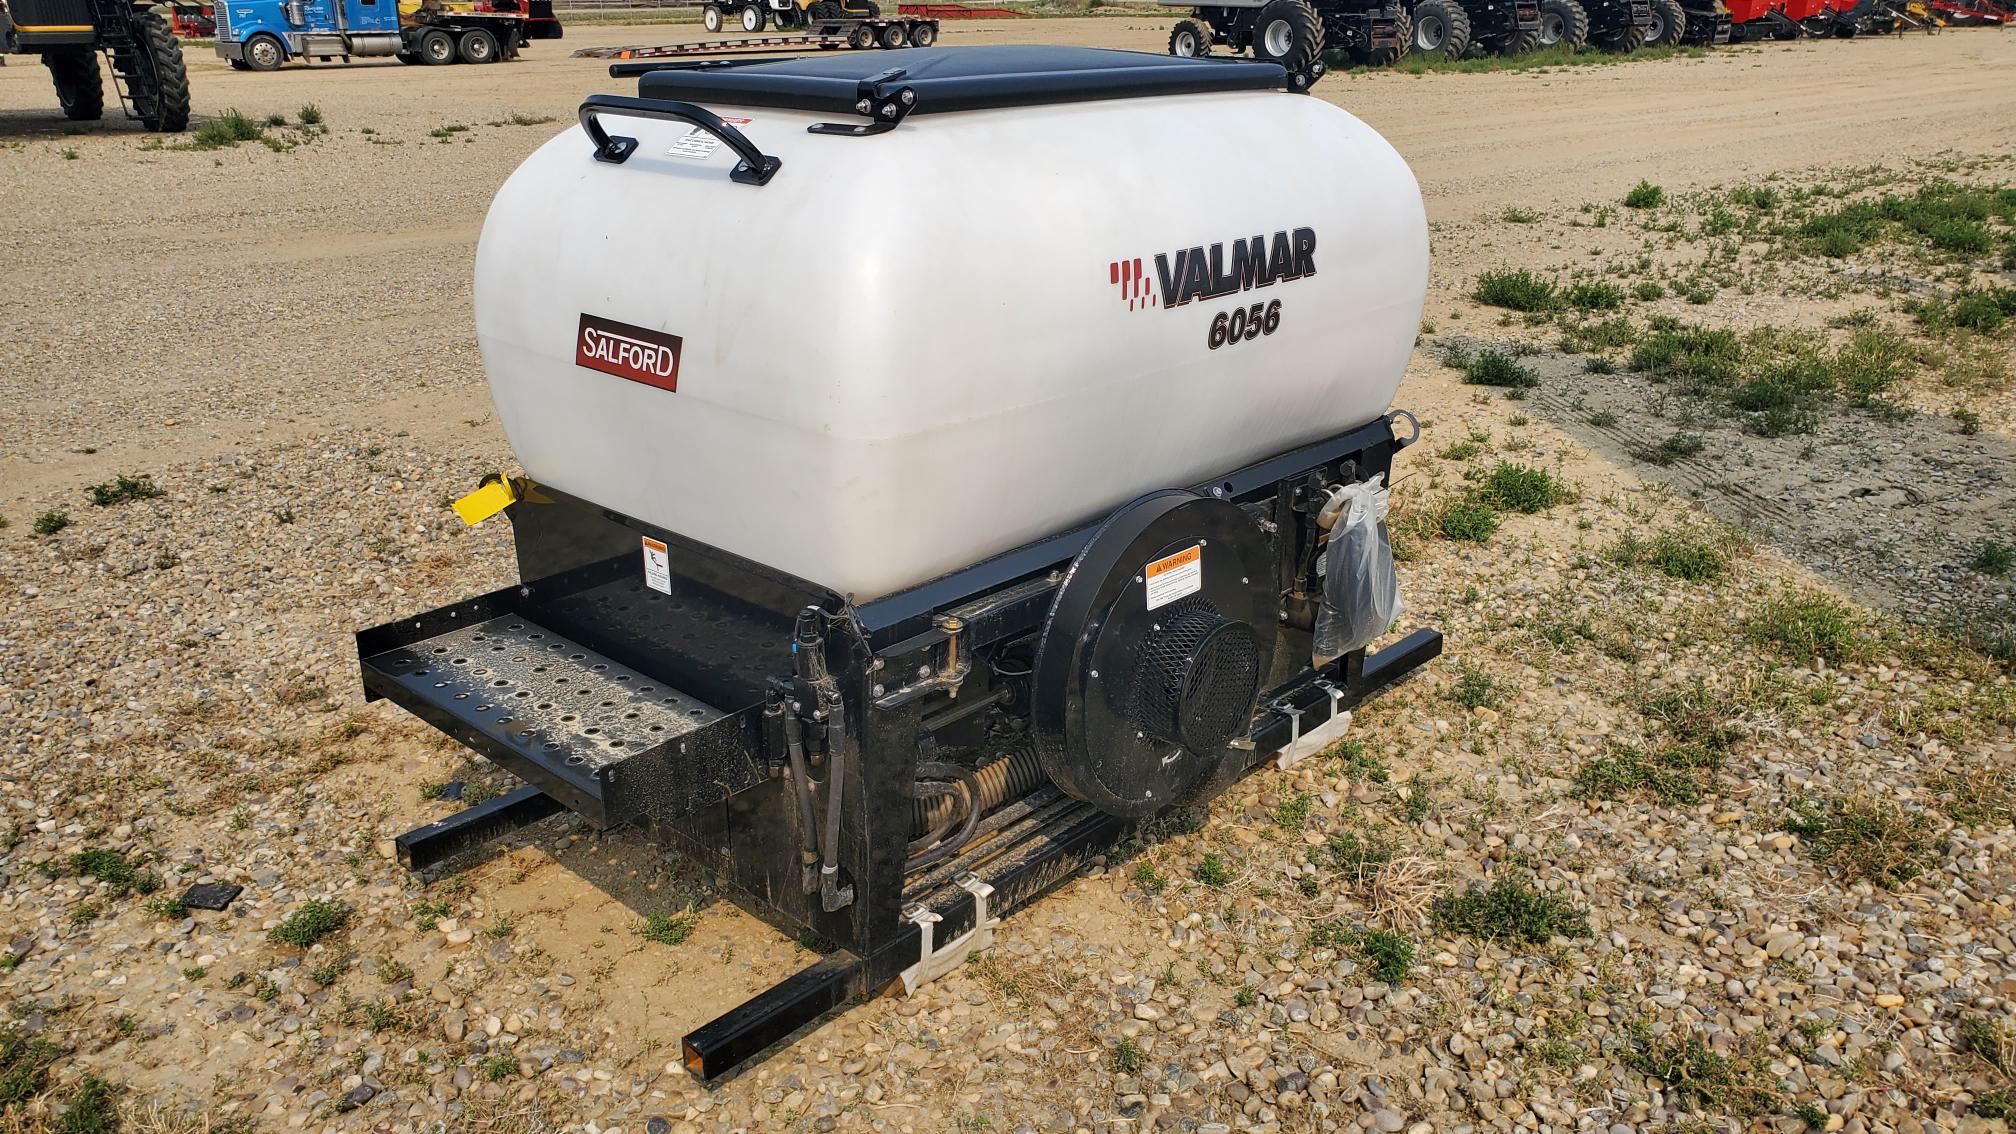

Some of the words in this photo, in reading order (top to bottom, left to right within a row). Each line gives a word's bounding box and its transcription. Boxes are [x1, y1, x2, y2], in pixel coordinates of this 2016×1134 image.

[1154, 226, 1317, 309] VALMAR
[1208, 298, 1282, 350] 6056
[583, 327, 673, 377] SALFORD
[1162, 552, 1192, 571] WARNING
